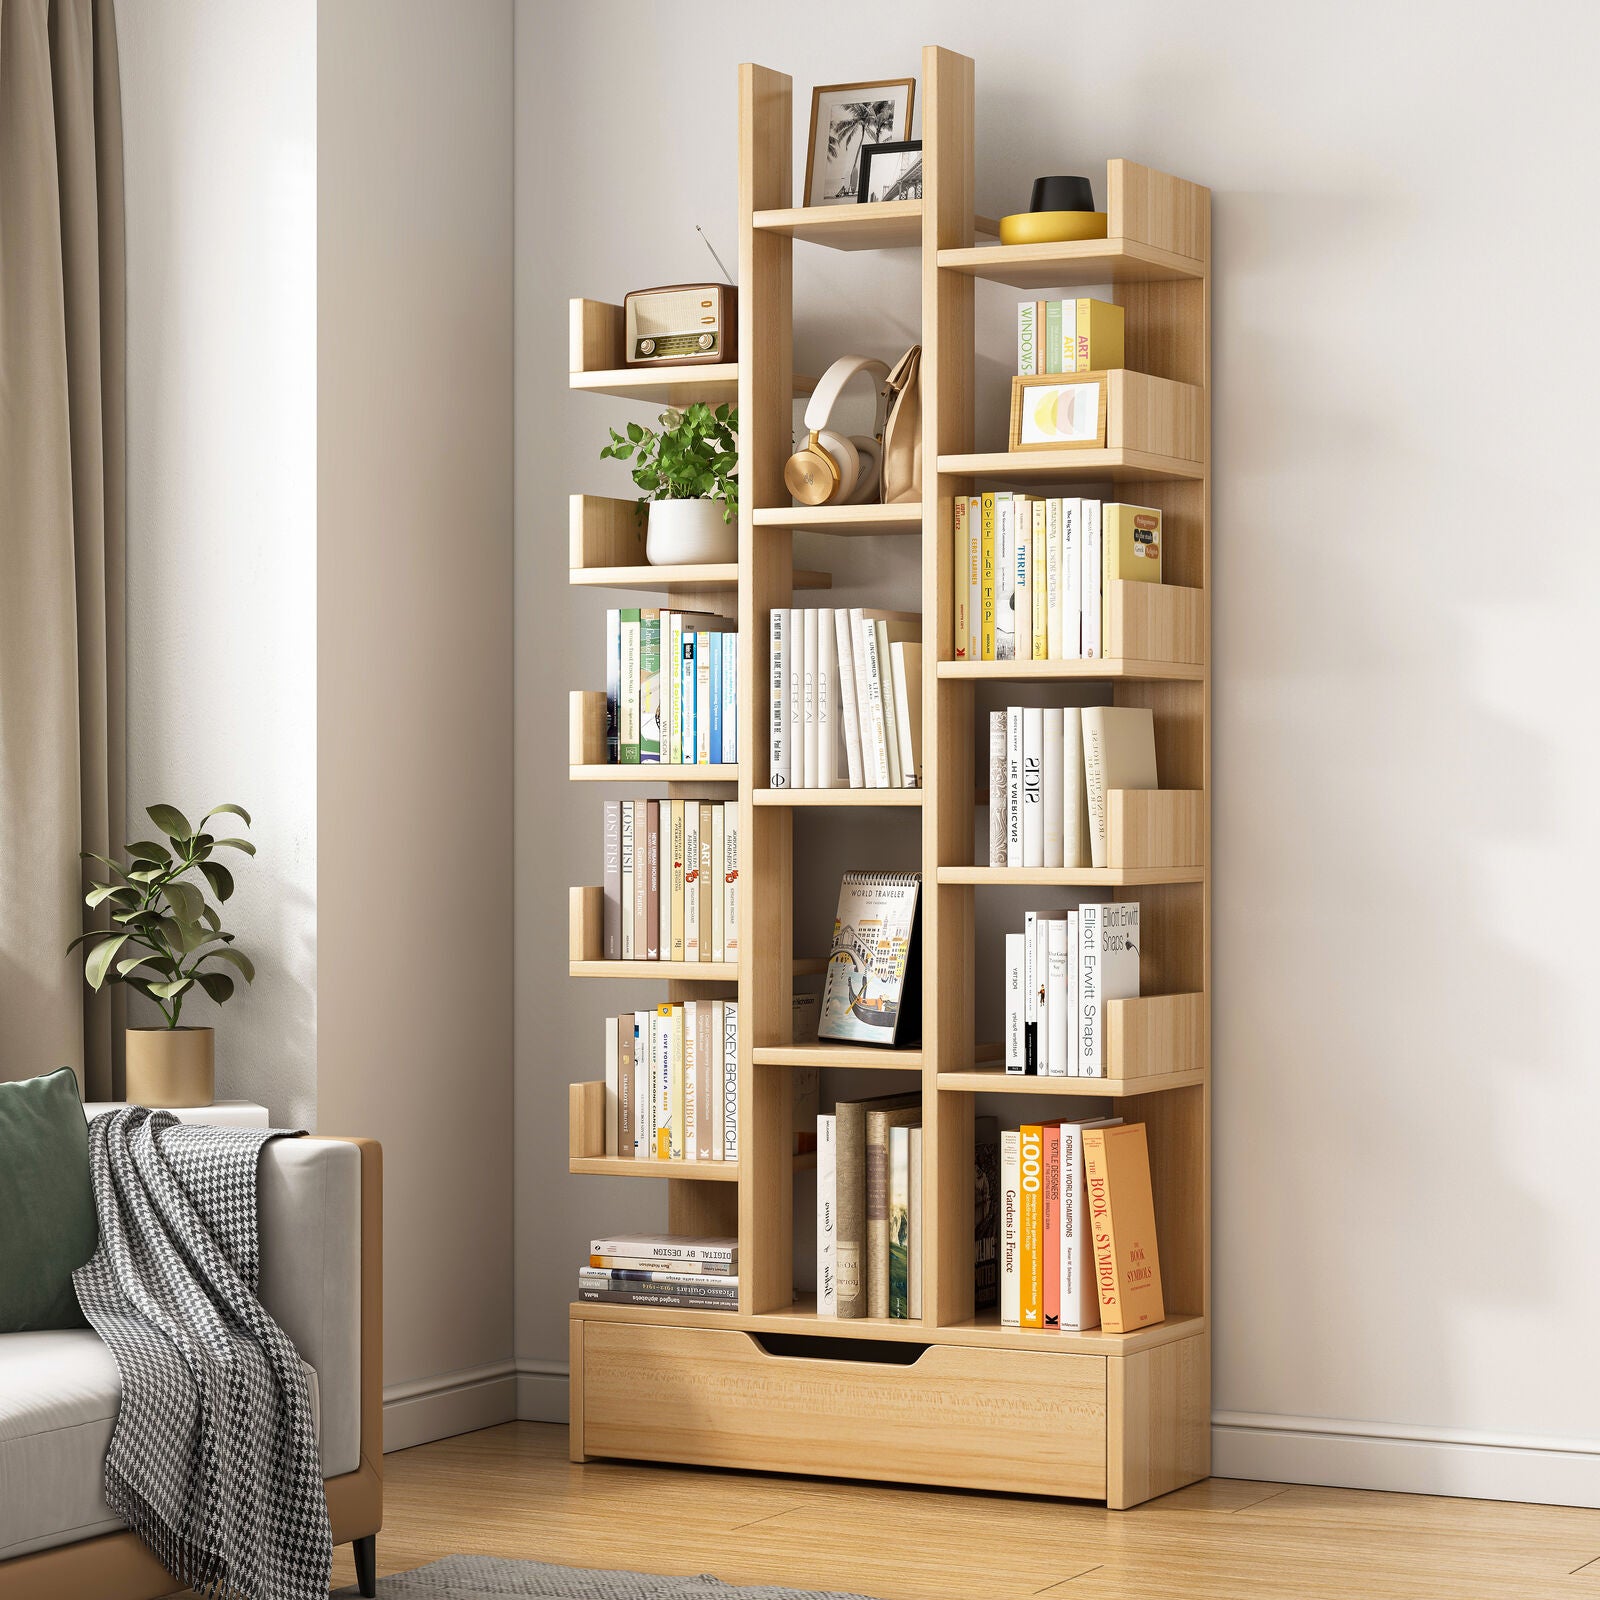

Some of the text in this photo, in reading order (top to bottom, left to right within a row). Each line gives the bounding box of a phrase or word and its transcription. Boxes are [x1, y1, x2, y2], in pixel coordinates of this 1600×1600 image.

[1022, 307, 1032, 370] WINDOWS
[1064, 336, 1074, 360] ART
[1079, 336, 1088, 359] ART
[984, 499, 992, 538] Over
[1017, 545, 1025, 587] THRIFT
[984, 587, 992, 621] Top
[869, 642, 877, 678] UNCOMMON
[607, 805, 617, 873] LOST FISH
[623, 806, 632, 874] LOST FISH
[701, 842, 710, 867] ART
[637, 847, 645, 879] Gardens
[851, 889, 905, 898] WORLD TRAVELER
[1102, 907, 1120, 927] Elliott
[1103, 931, 1124, 956] Snaps
[1082, 908, 1096, 1057] Elliott Erwitt Snaps
[685, 1039, 694, 1138] BOOK SYMBOLS
[726, 1006, 736, 1150] ALEXEY BRODOVITCH
[1022, 1132, 1040, 1192] 1000
[1090, 1178, 1107, 1219] BOOK
[1006, 1190, 1015, 1273] Gardens in France
[1065, 1199, 1073, 1238] CHAMPIONS
[1095, 1222, 1102, 1231] OF
[653, 1248, 682, 1257] DESIGN
[700, 1250, 732, 1260] DIGITAL
[1095, 1234, 1116, 1305] SYMBOLS
[1130, 1248, 1145, 1263] BOOK
[659, 1296, 680, 1304] tangled
[676, 1286, 706, 1296] Guitars
[707, 1288, 735, 1297] Picasso
